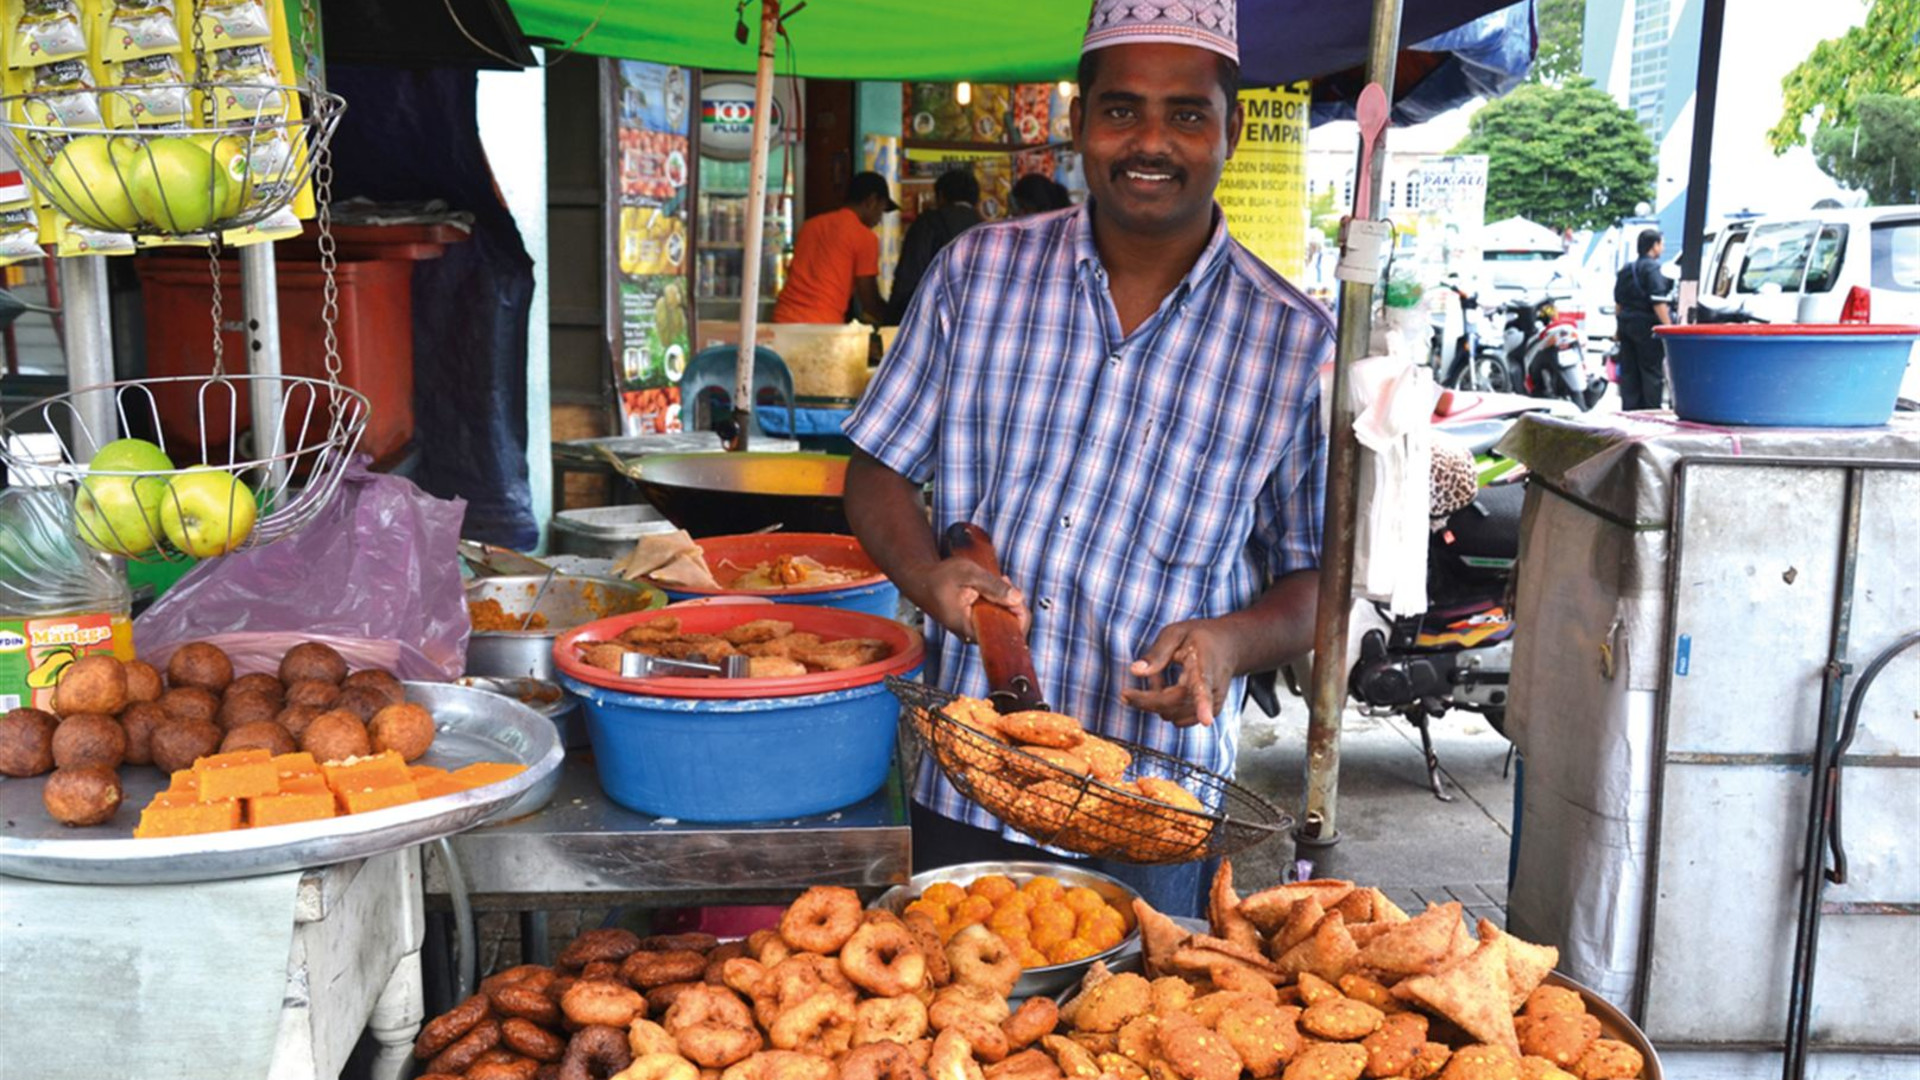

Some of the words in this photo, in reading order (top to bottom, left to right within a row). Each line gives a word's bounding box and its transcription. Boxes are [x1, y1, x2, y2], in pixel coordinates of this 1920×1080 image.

[713, 101, 751, 121] 100
[713, 124, 750, 133] PLUS
[1246, 123, 1305, 144] EMPA
[32, 627, 110, 644] Mangga
